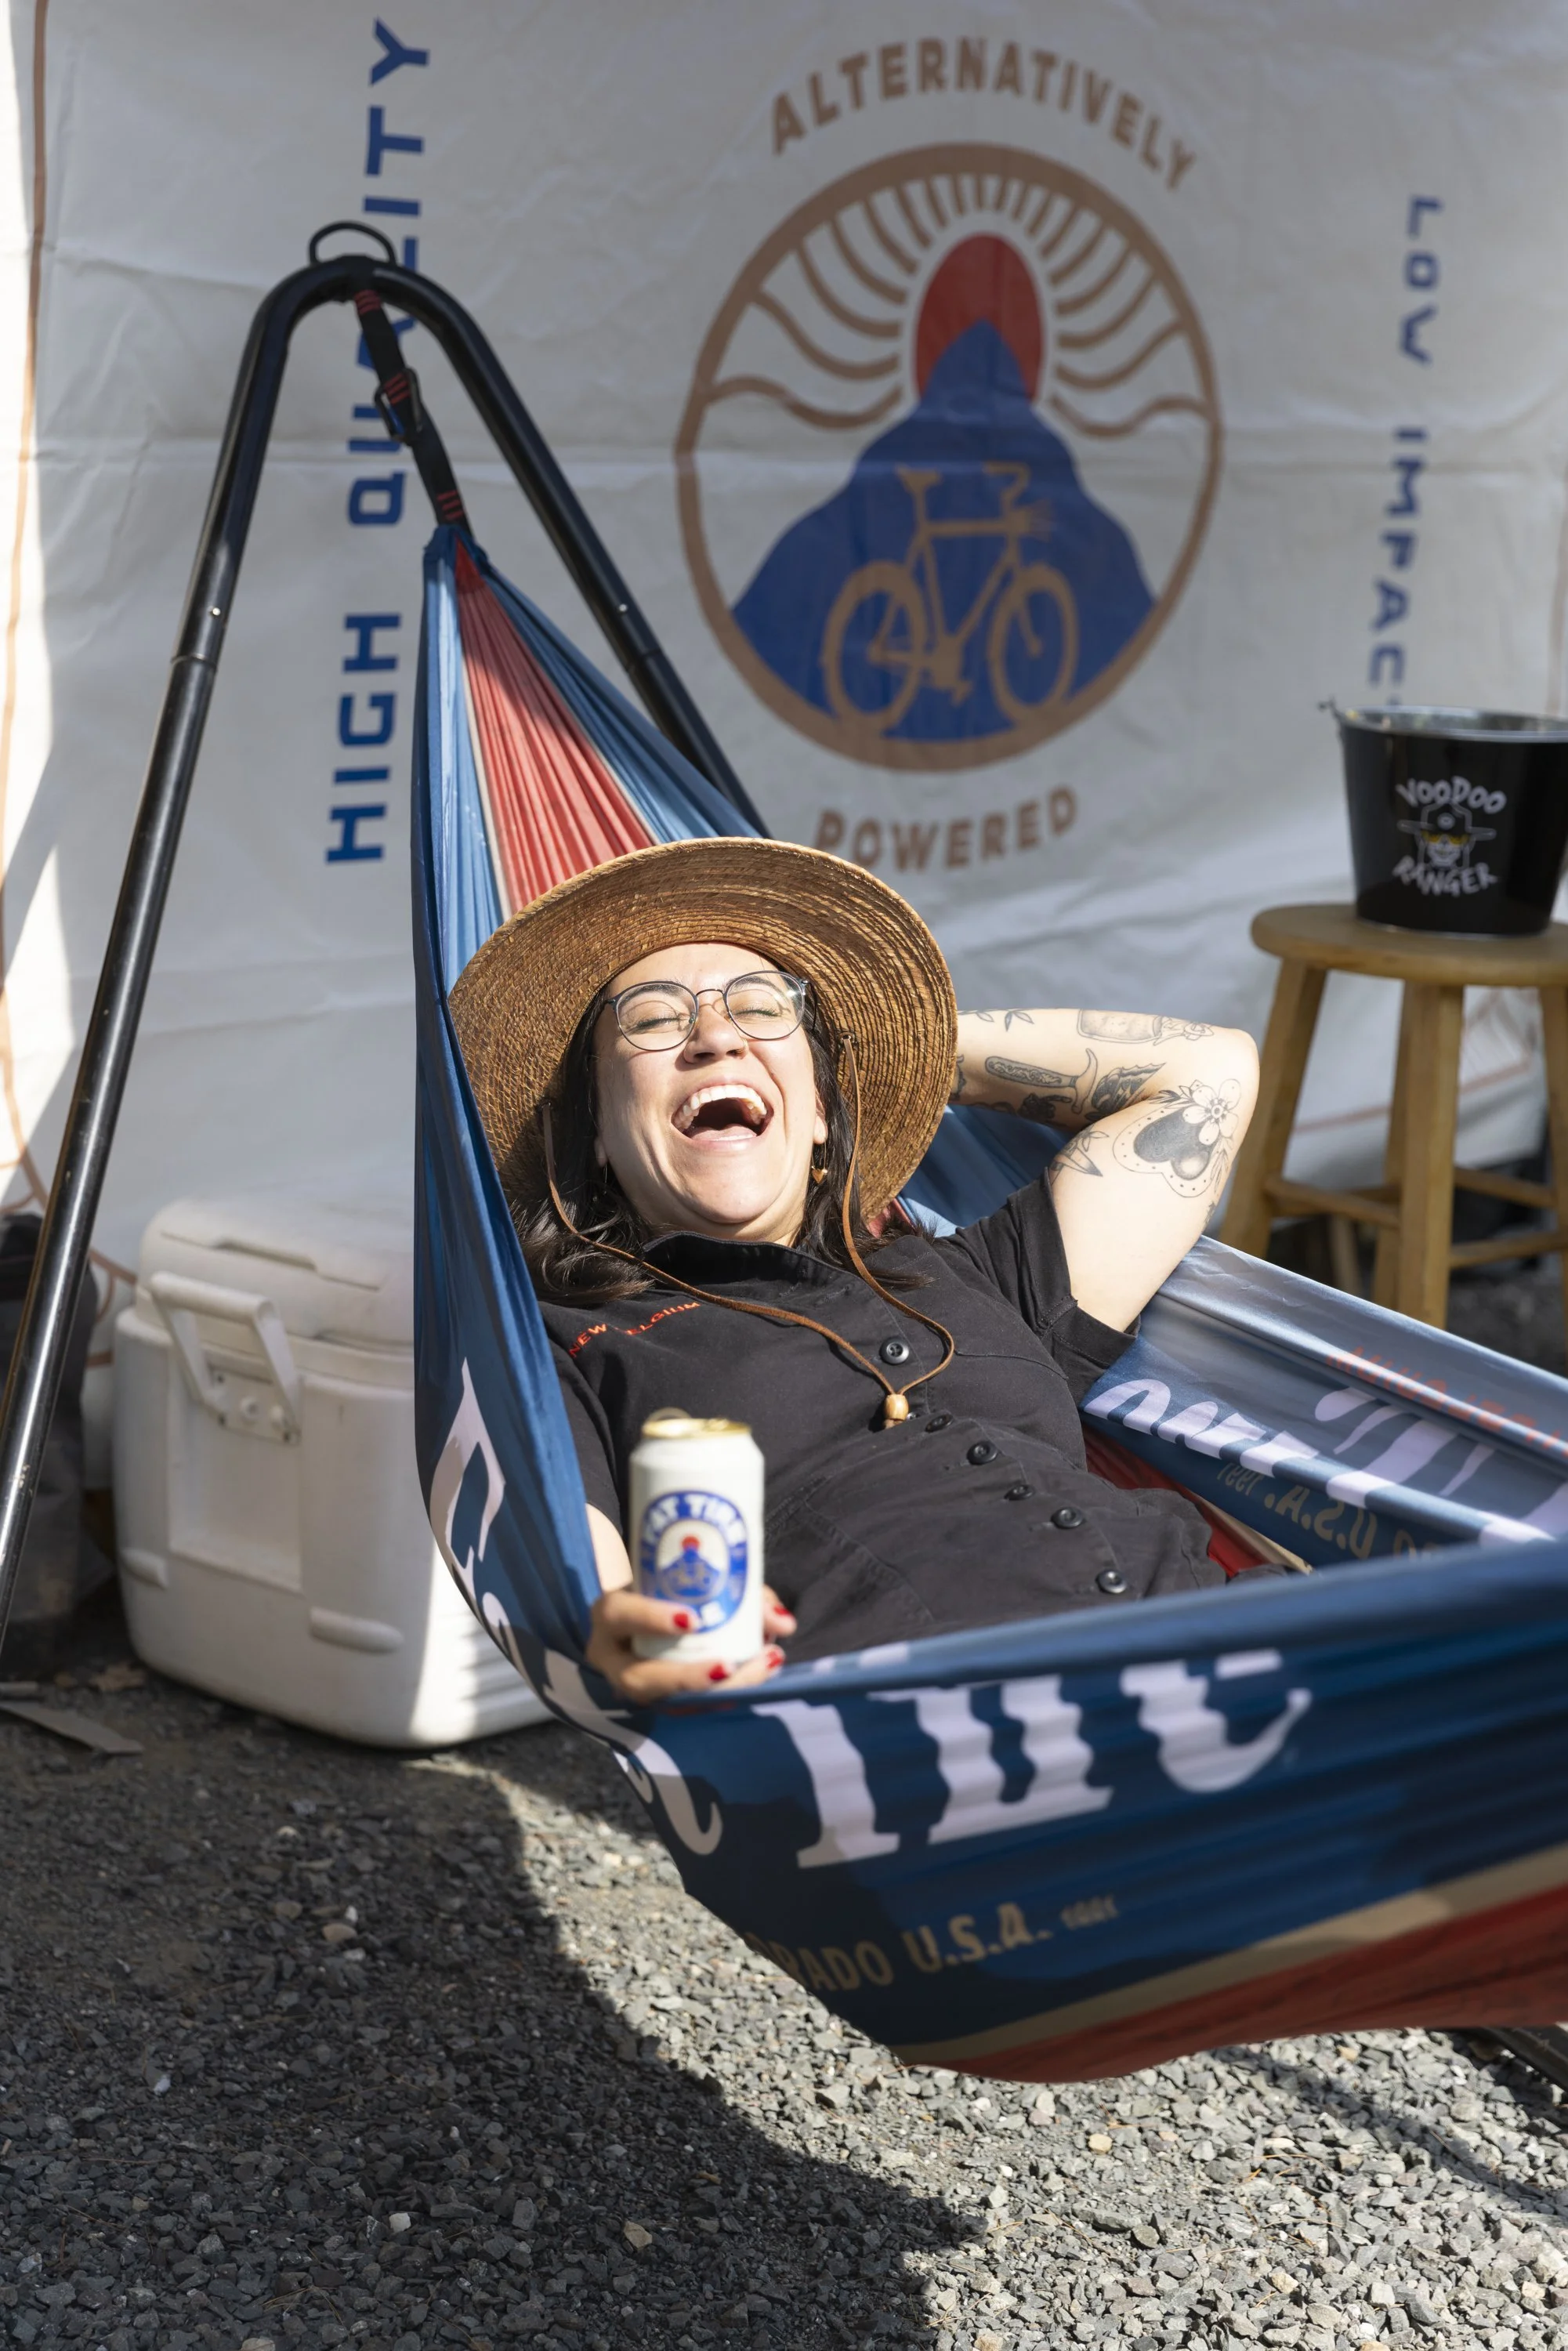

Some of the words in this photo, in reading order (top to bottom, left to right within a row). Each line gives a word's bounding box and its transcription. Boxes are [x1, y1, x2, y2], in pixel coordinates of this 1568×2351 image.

[772, 34, 1196, 191] ALTERNATIVELY
[1367, 424, 1429, 708] IMPAC
[324, 612, 402, 864] HIGH
[813, 784, 1078, 874] POWERED
[1396, 775, 1508, 814] VOODOO
[1392, 855, 1498, 897] RANGER
[569, 1324, 607, 1358] NEW
[614, 1302, 701, 1335] ELGIUM
[901, 1902, 1054, 1973] U.S.A.
